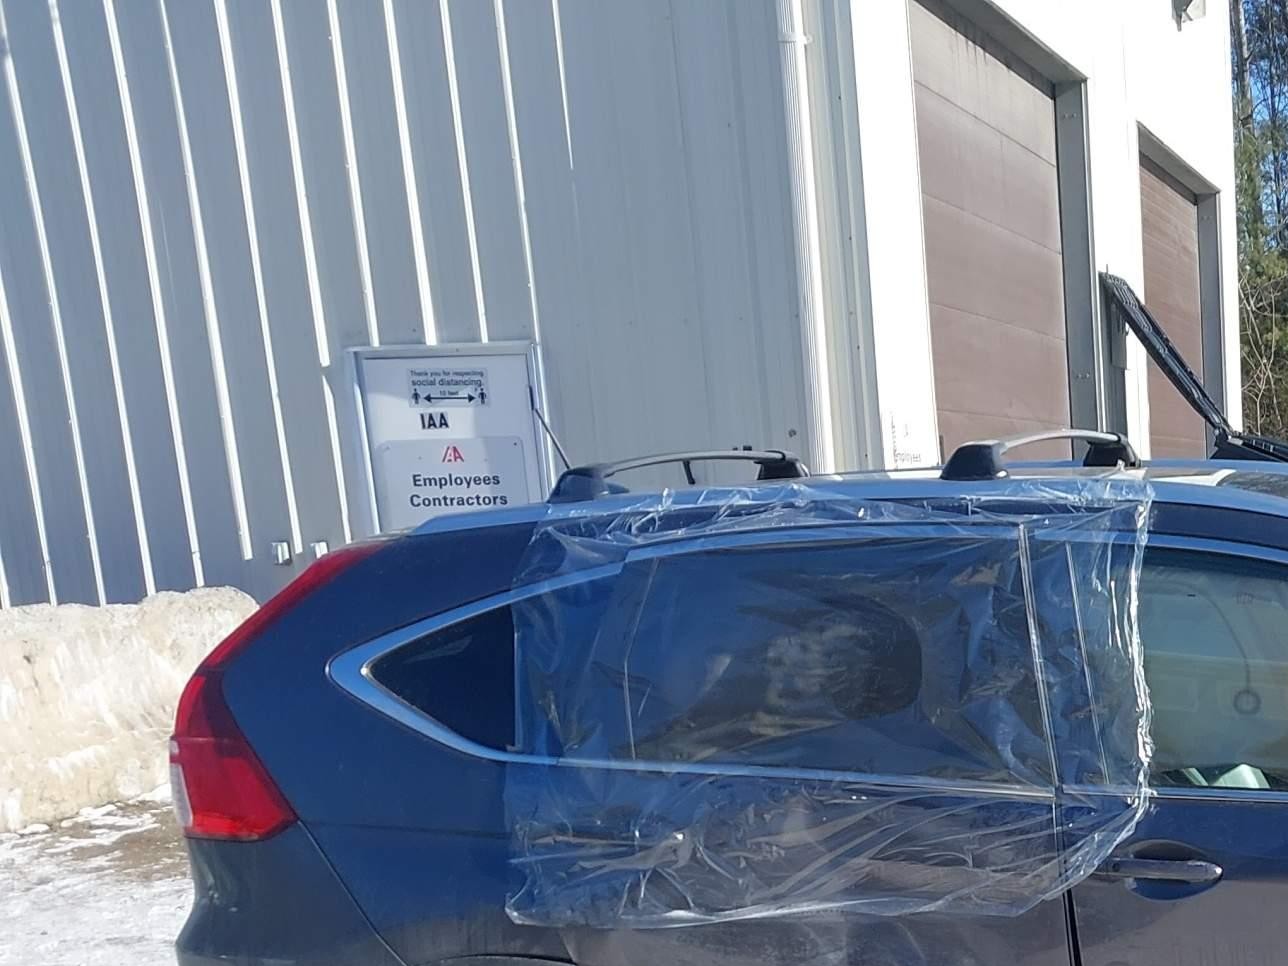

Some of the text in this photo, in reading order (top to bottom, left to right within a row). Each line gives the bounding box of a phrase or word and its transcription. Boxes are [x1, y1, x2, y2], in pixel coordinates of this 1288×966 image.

[411, 378, 436, 386] social
[420, 412, 449, 429] IAA
[412, 473, 501, 489] Employees
[409, 494, 508, 508] Contractors
